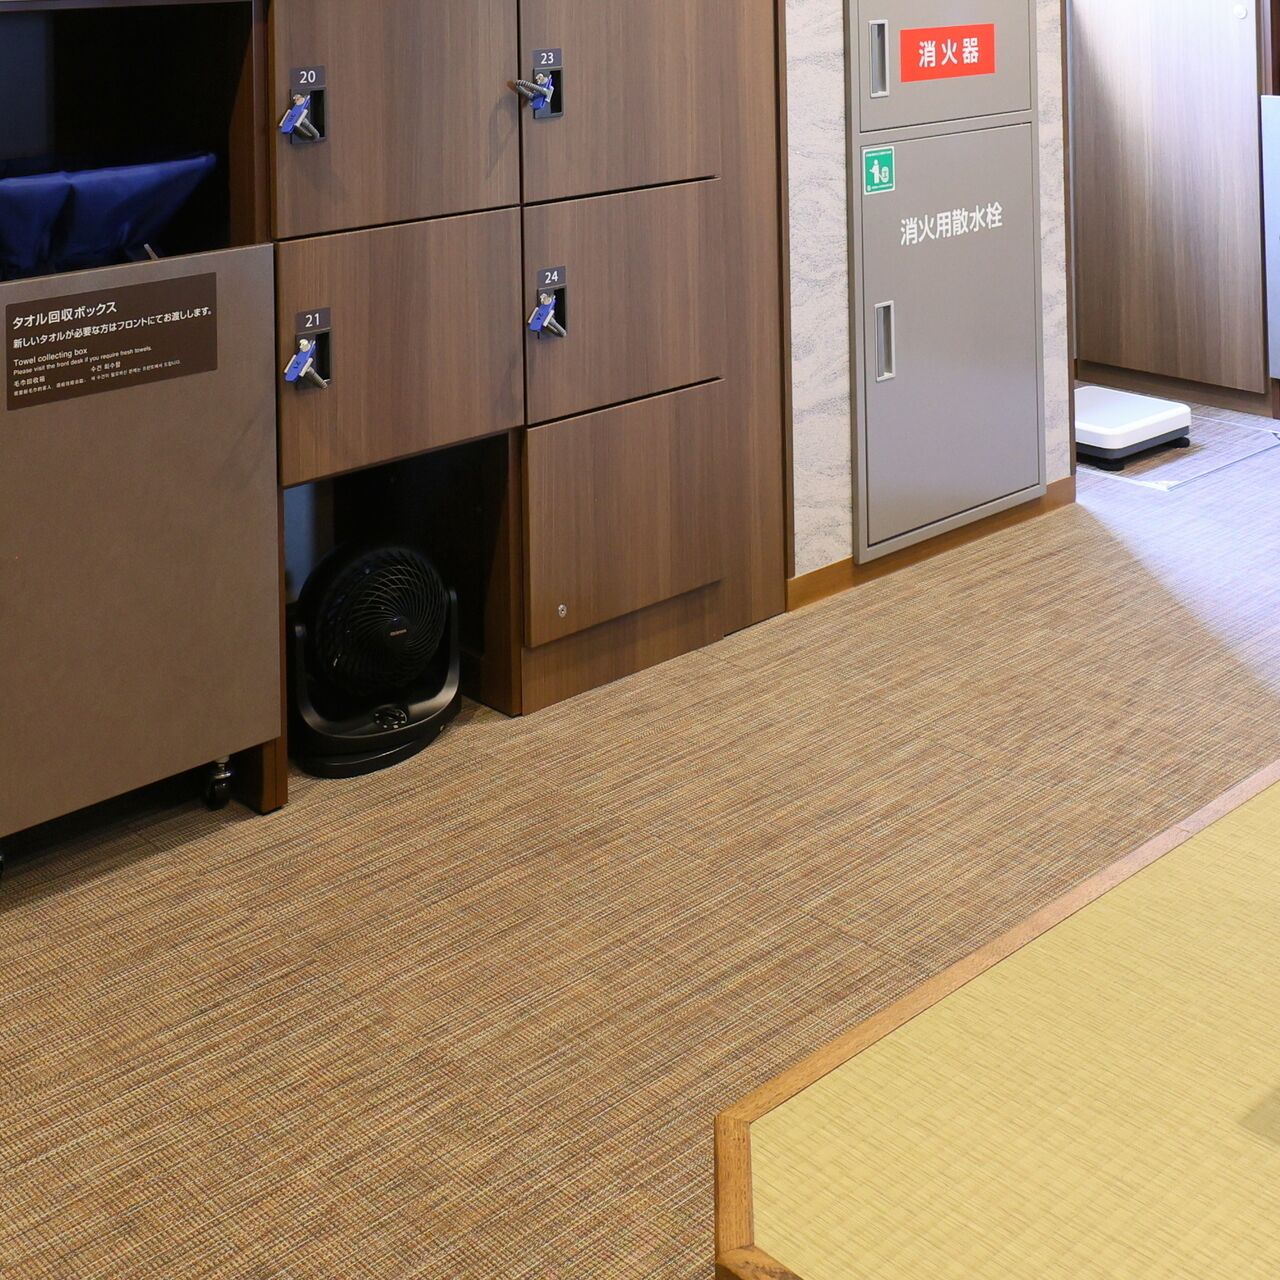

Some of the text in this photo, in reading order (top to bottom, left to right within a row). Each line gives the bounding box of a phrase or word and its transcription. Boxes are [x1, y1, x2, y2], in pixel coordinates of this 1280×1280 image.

[540, 52, 554, 65] 23
[918, 37, 979, 68] 消火器
[299, 70, 316, 84] 20
[900, 202, 1003, 246] 消火用散水栓
[544, 270, 559, 284] 24
[12, 301, 117, 330] タオル回収ボックス
[305, 313, 320, 328] 21
[13, 307, 212, 349] 新しいタオルが必要な方はフロントにてお渡しします。
[13, 348, 88, 367] Towel collecting box
[13, 368, 32, 376] Please
[56, 360, 69, 368] front
[100, 352, 119, 360] require
